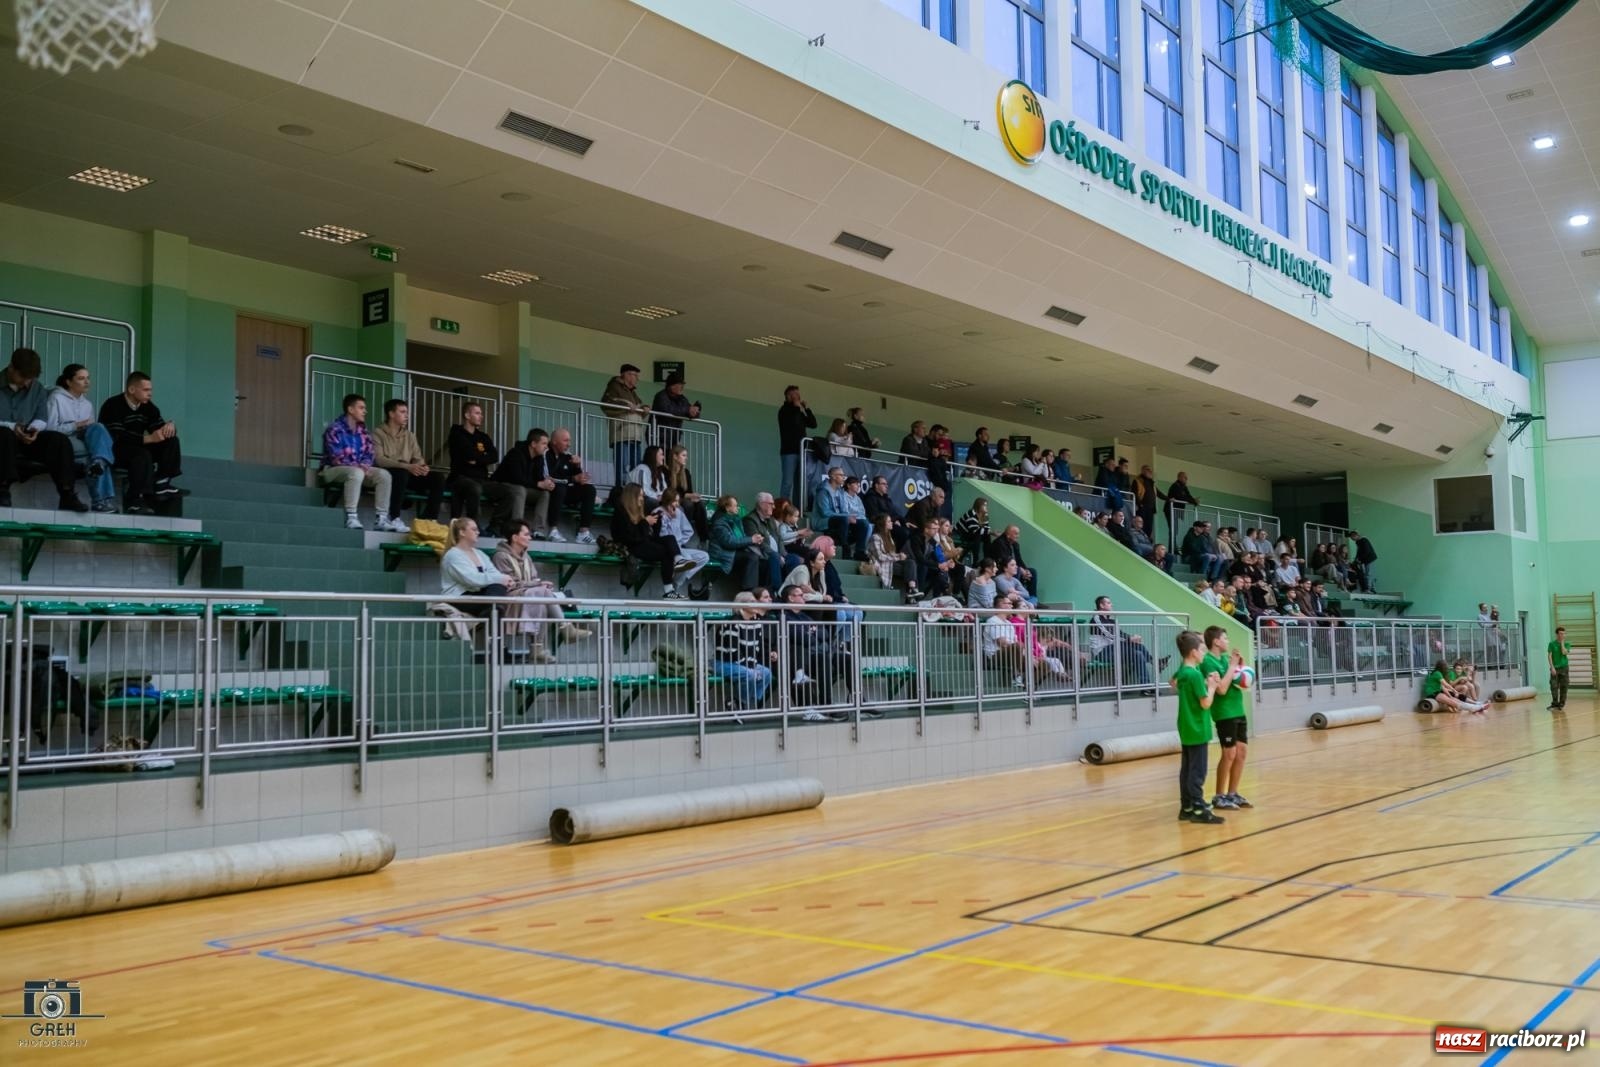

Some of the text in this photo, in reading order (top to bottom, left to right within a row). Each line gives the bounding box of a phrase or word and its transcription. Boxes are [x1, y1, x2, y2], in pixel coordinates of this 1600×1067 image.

[1050, 120, 1333, 299] OŚRODEK SPORTU I REKREACJI RACIBÓRZ
[369, 301, 383, 322] E
[1015, 441, 1026, 450] F
